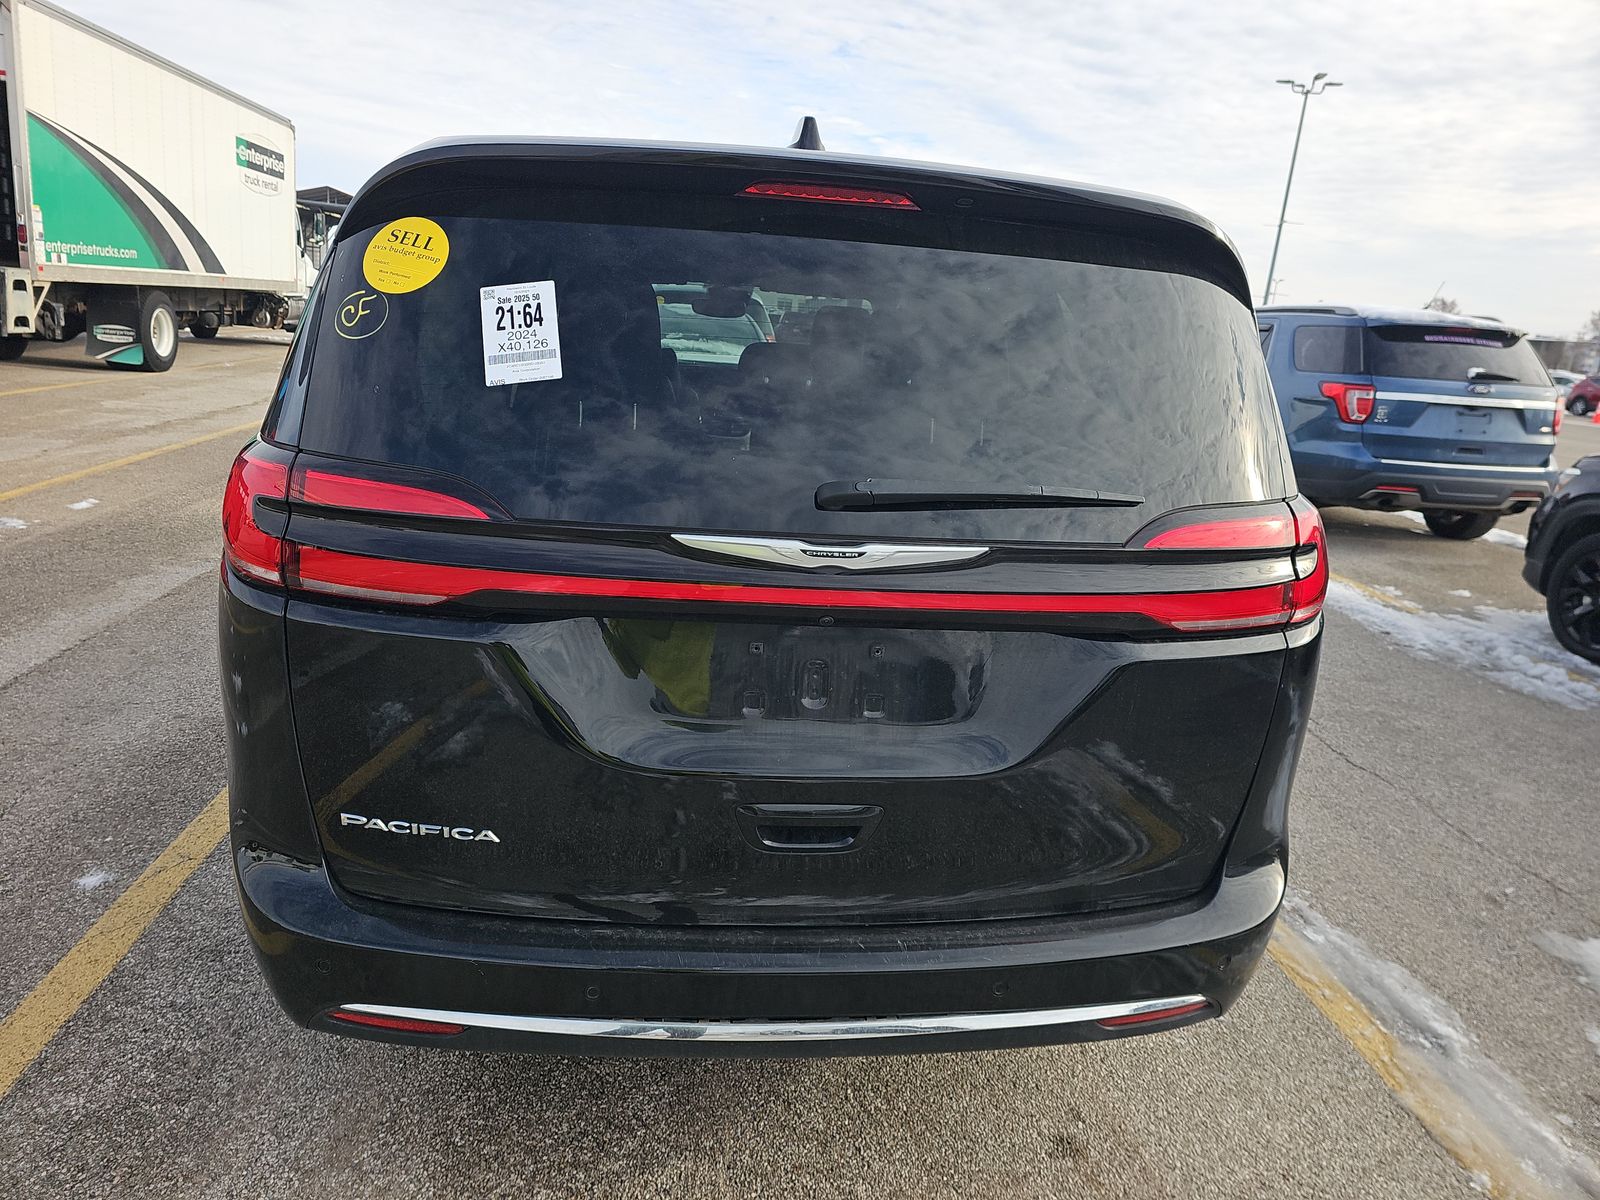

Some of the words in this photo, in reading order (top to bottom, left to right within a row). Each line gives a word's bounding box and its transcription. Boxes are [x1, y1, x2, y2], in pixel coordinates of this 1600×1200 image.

[237, 145, 284, 173] enterprise
[244, 173, 261, 187] truck
[262, 180, 279, 192] rental
[387, 229, 434, 251] SELL
[45, 241, 138, 259] enterprisetrucks.com
[389, 246, 416, 256] budget
[416, 253, 441, 264] group
[514, 294, 531, 303] 2025
[532, 293, 541, 301] 50
[495, 302, 544, 331] 21:64
[507, 329, 538, 341] 2024
[489, 378, 506, 386] AVIS
[340, 812, 501, 843] PACIFICA
